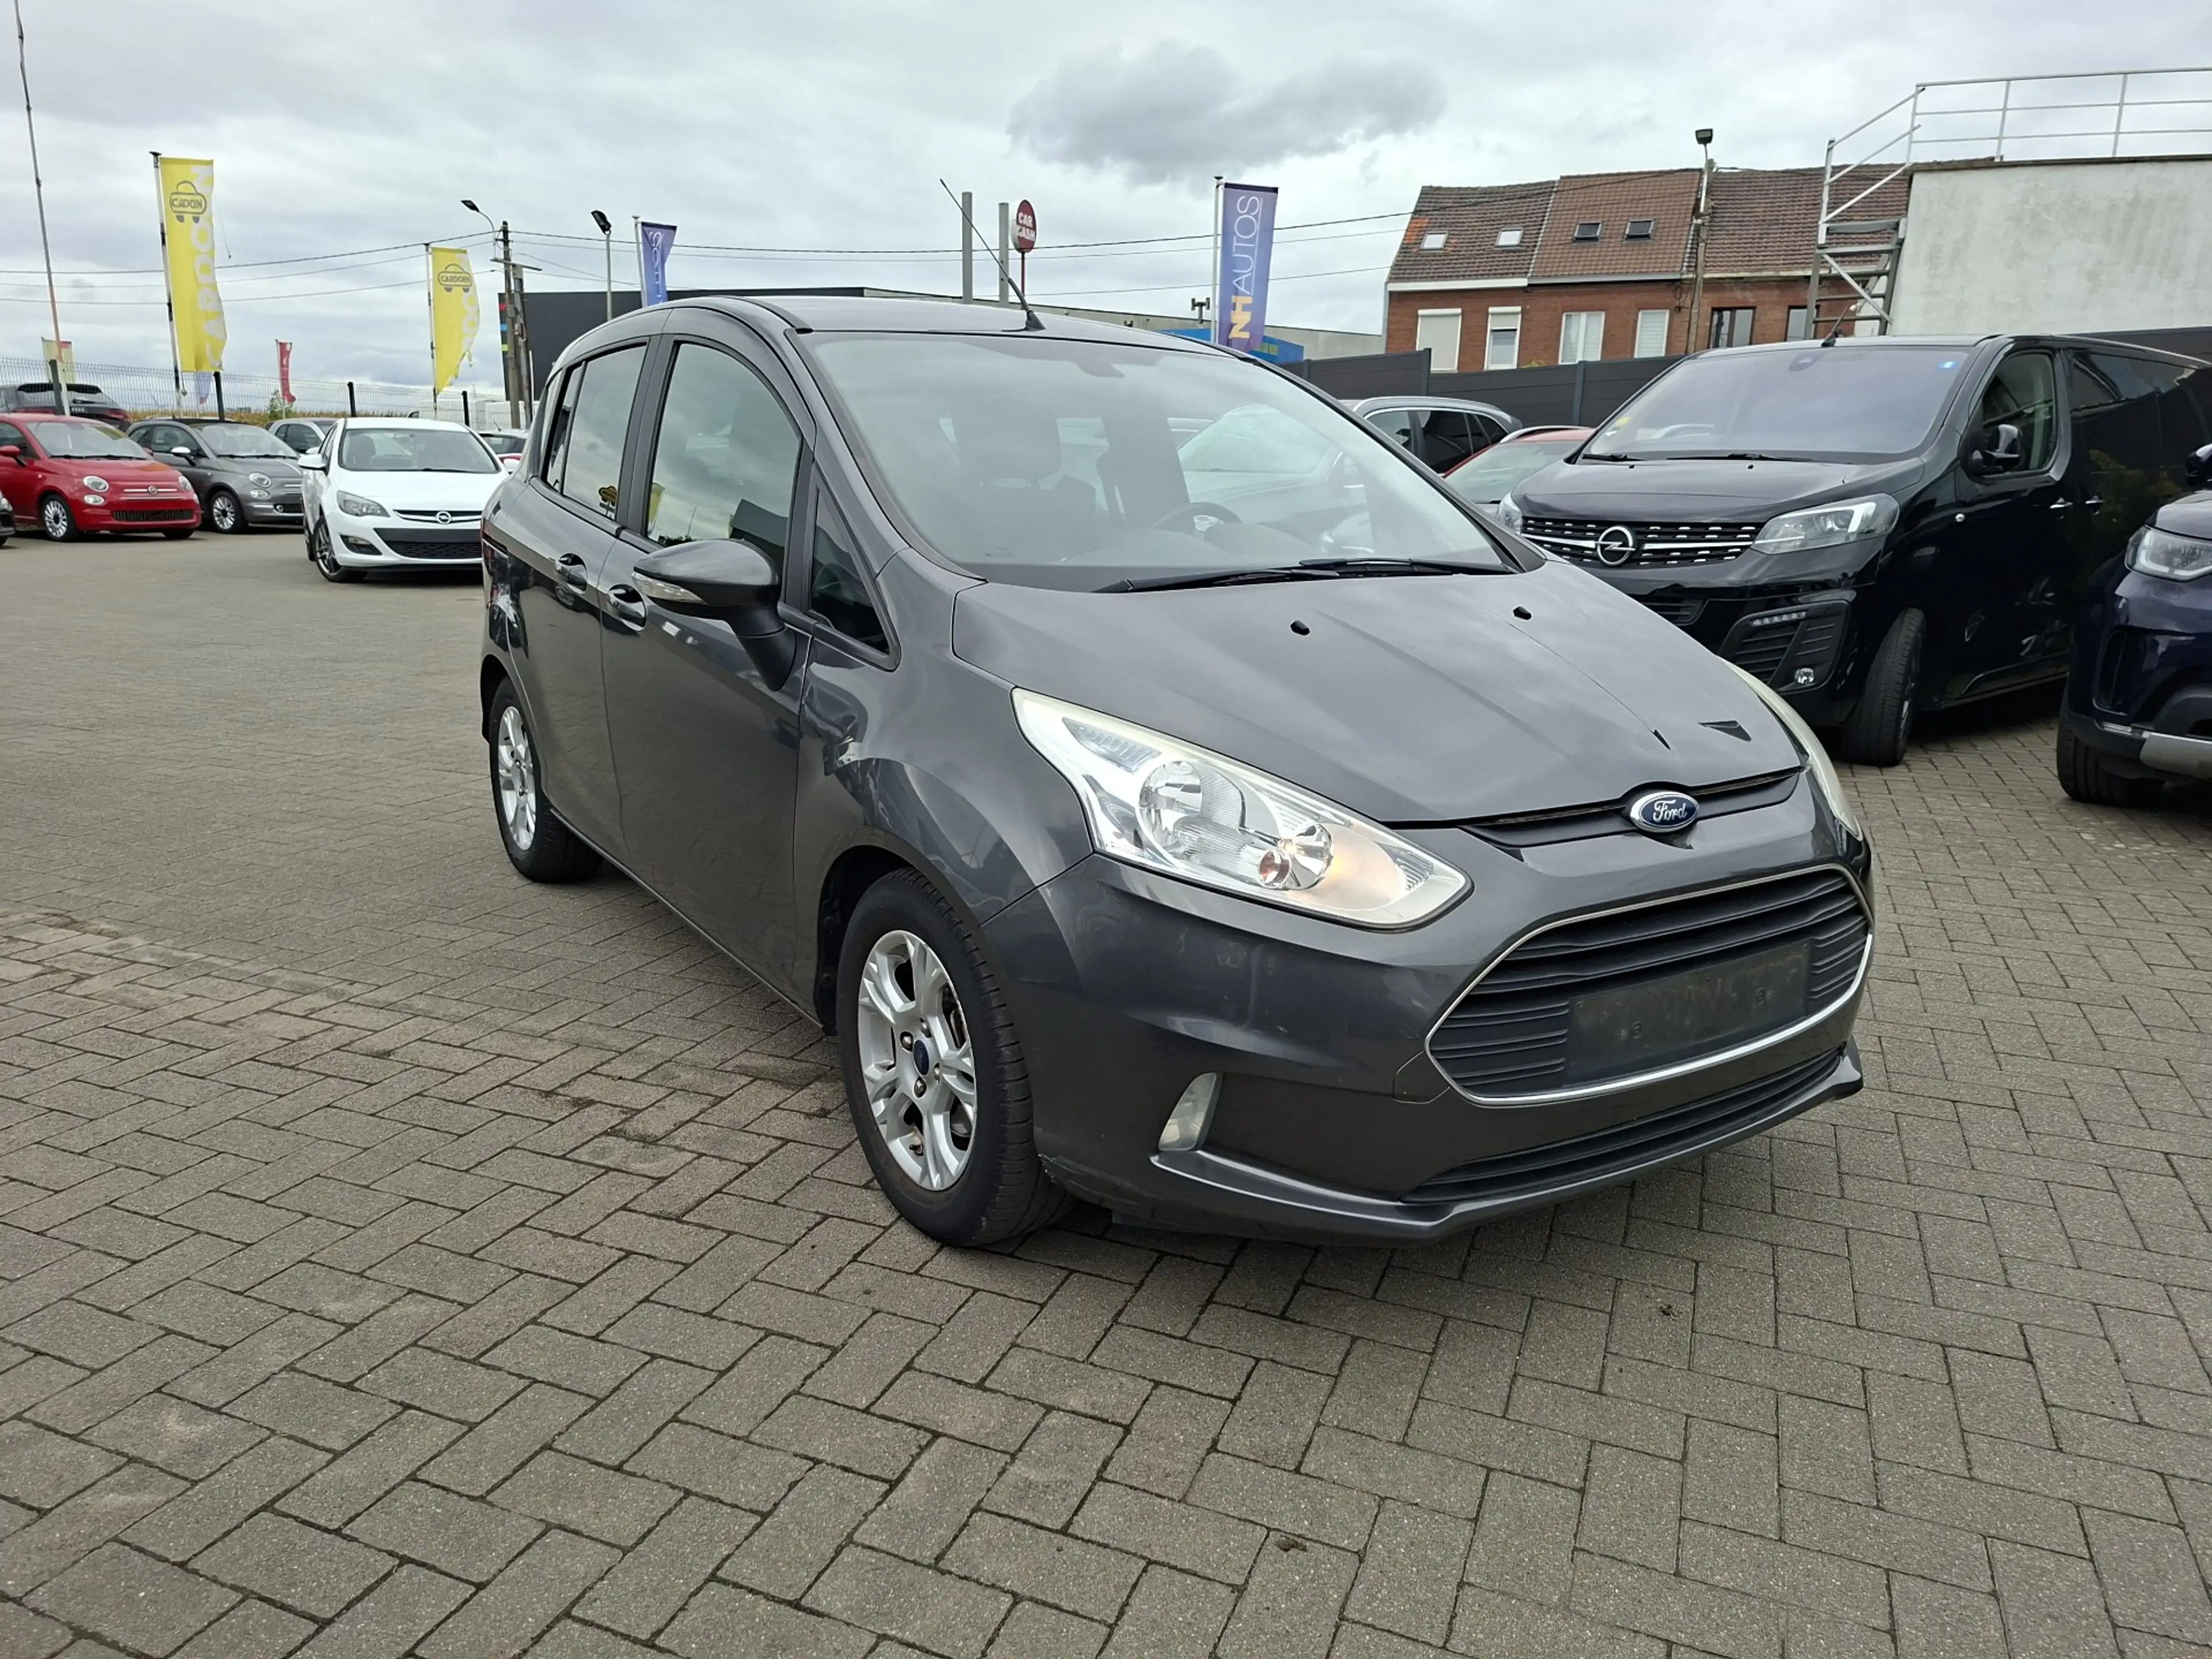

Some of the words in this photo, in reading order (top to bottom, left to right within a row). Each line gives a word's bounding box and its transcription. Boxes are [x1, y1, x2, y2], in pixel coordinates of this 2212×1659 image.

[1018, 212, 1033, 228] CAR
[191, 165, 227, 369] CARDON
[1653, 800, 1687, 822] Ford
